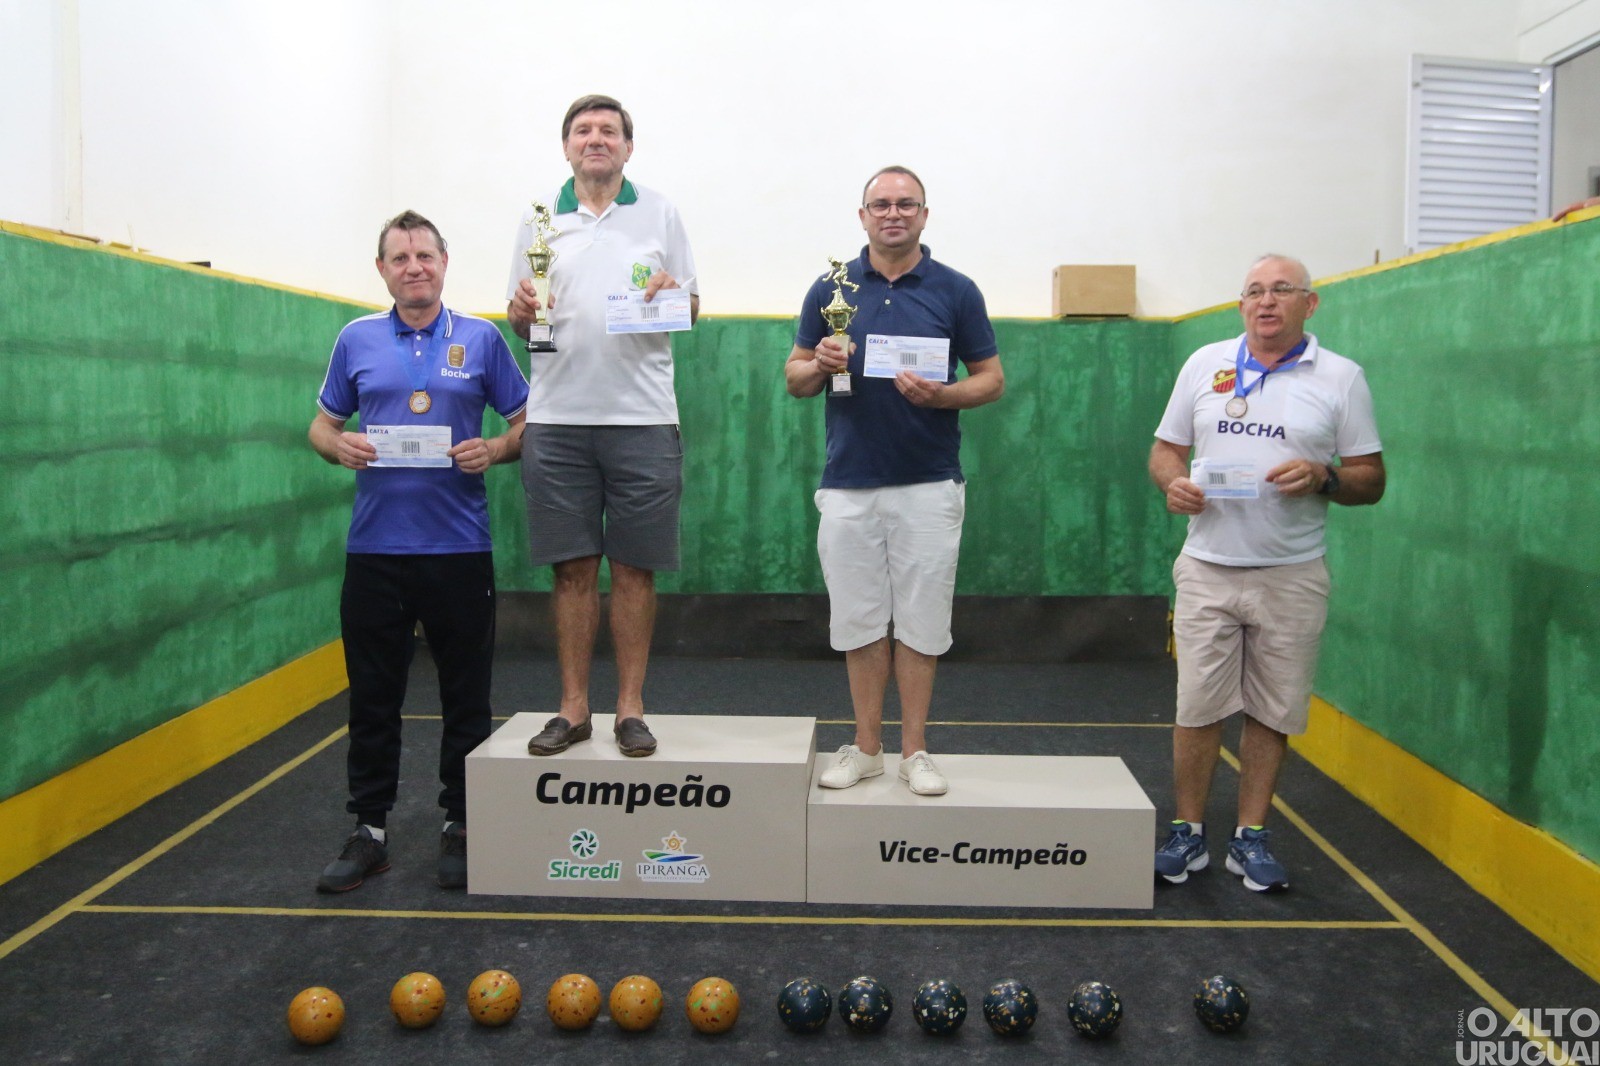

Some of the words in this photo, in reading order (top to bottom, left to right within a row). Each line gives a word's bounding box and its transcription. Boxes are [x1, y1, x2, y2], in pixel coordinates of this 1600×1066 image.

[441, 368, 470, 379] Bocha
[1217, 420, 1286, 440] BOCHA
[536, 772, 731, 814] Campeão
[879, 840, 1087, 870] Vice-Campeão
[550, 861, 620, 879] Sicredi
[638, 864, 707, 876] IPIRANGA
